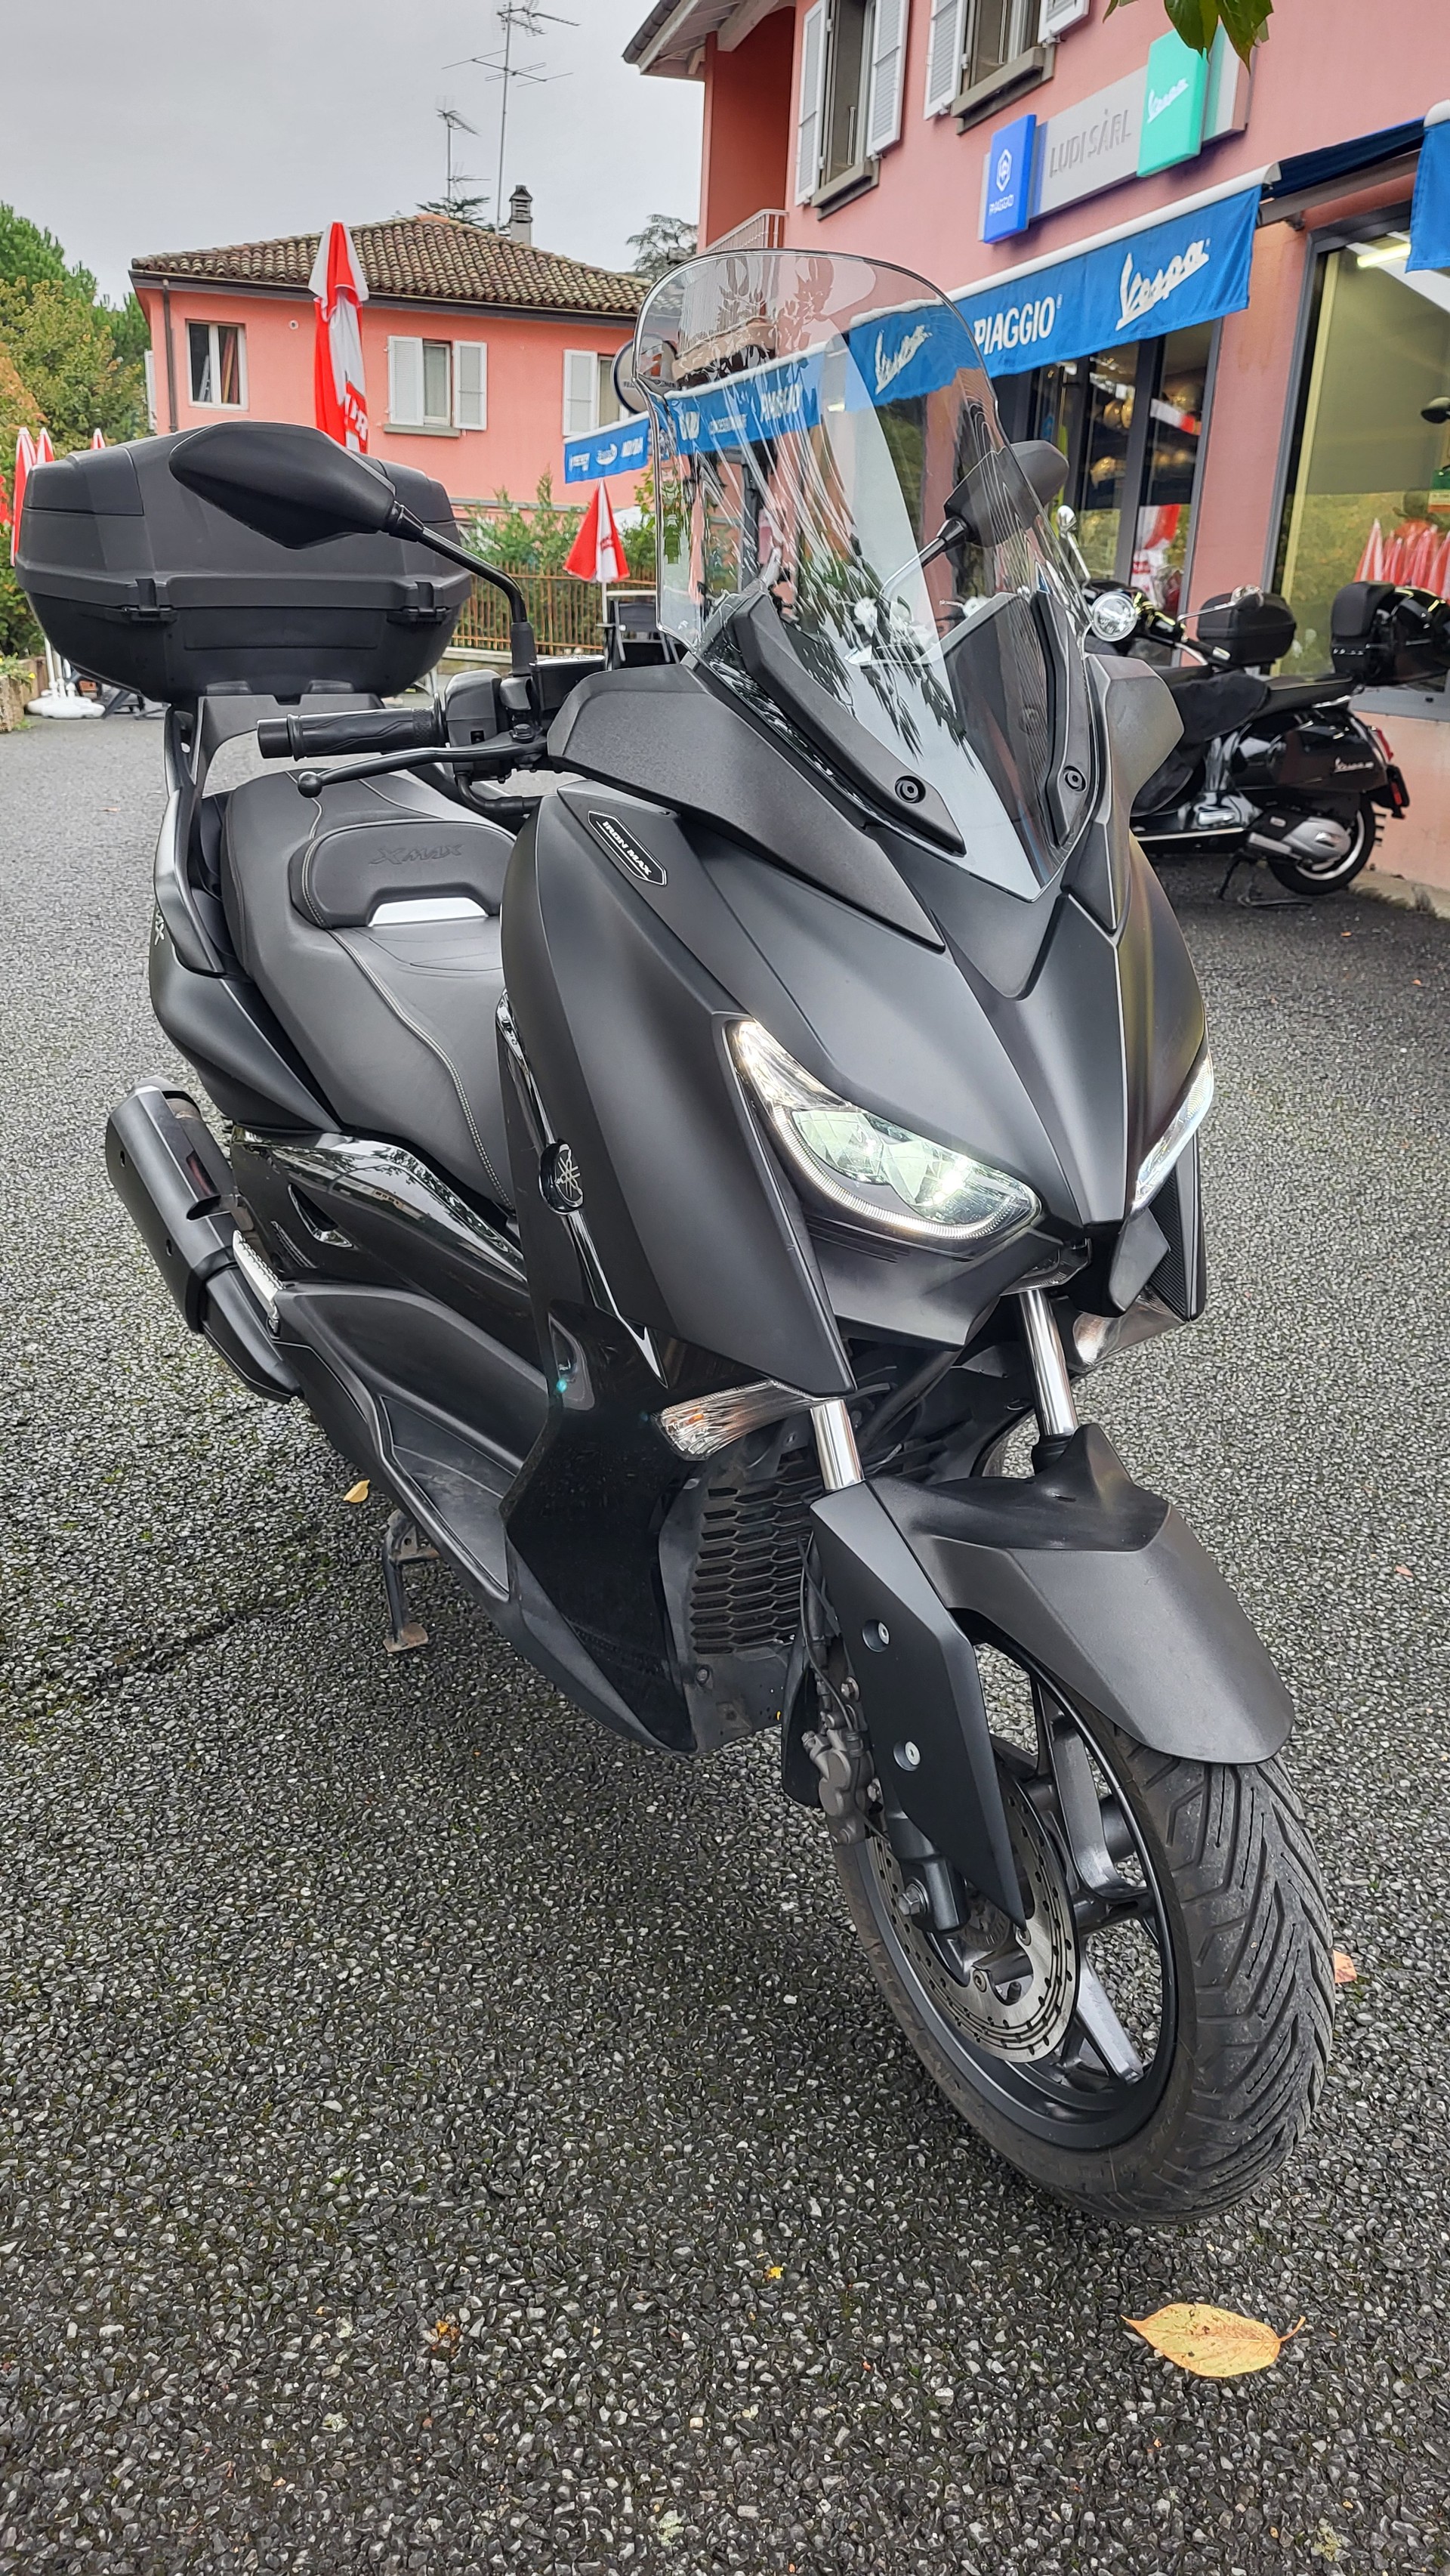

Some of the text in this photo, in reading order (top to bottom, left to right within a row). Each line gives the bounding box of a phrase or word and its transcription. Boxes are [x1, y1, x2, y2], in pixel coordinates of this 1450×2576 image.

[973, 240, 1210, 355] PIAGGIO Vespa
[602, 820, 652, 876] IRON MAX
